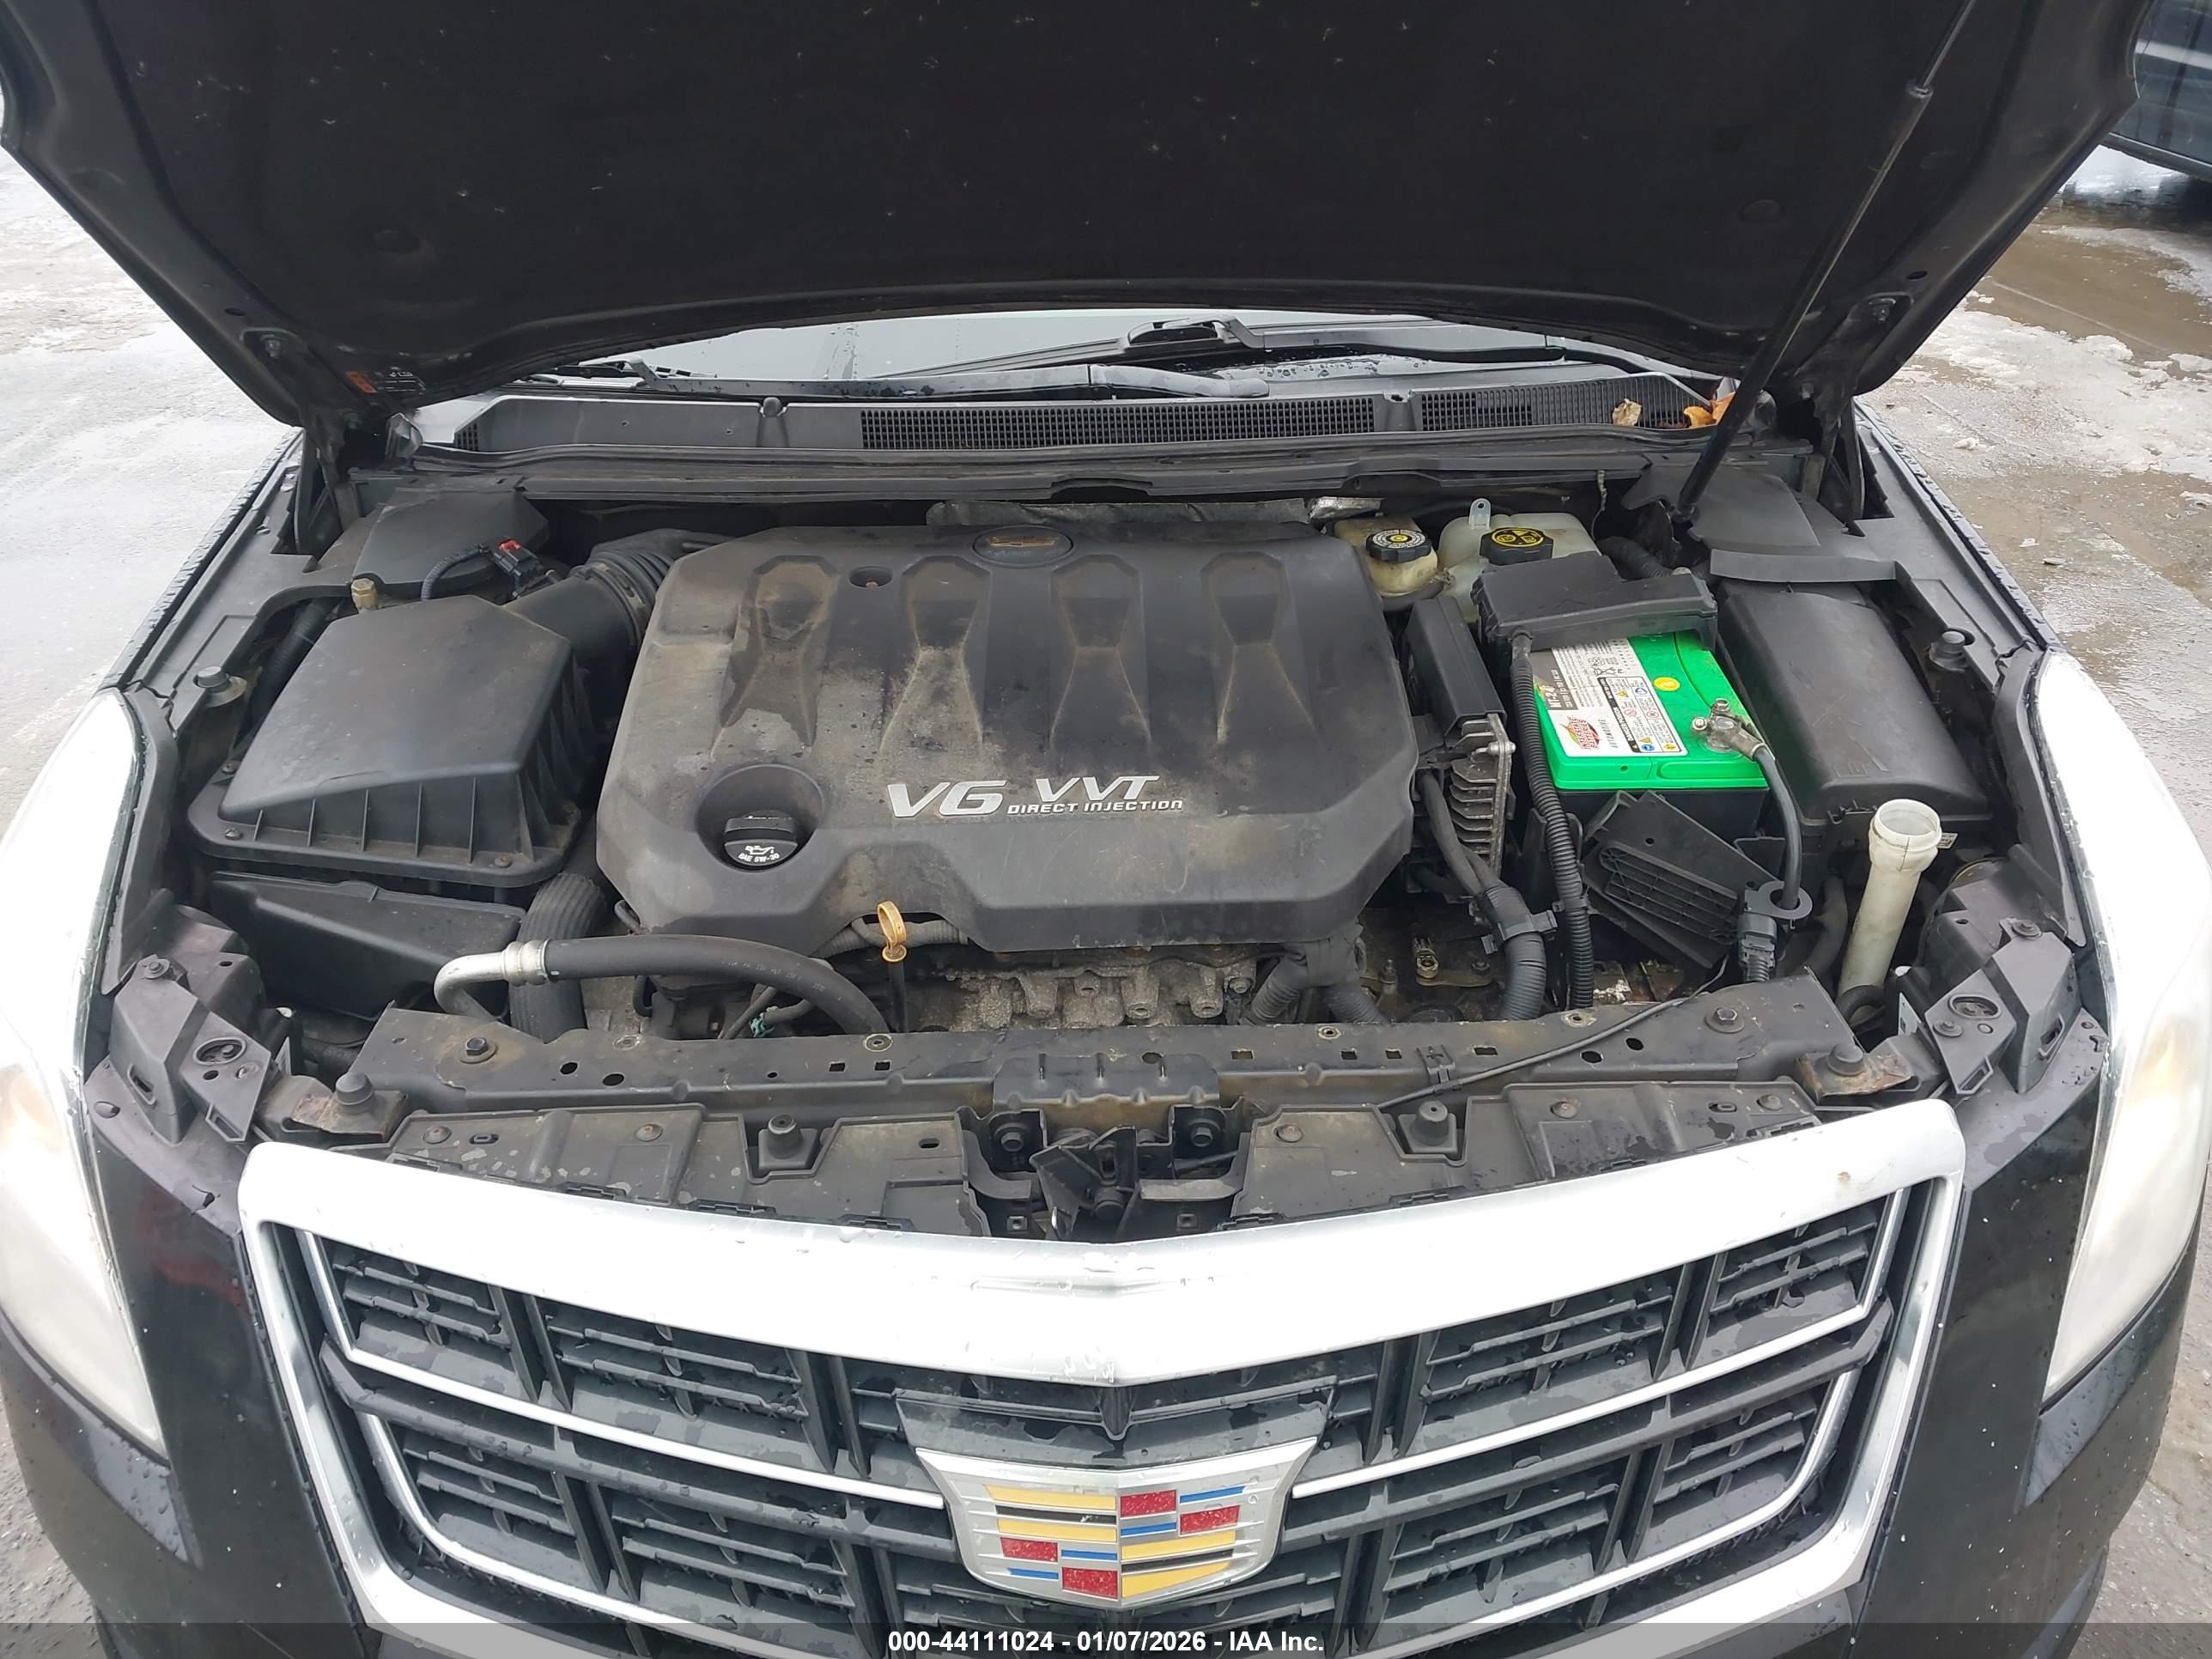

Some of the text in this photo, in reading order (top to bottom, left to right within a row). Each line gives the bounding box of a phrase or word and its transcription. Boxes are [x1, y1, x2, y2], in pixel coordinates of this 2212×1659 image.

[1567, 716, 1591, 750] INTERSTATE
[1578, 719, 1600, 750] BATTERIES
[1597, 719, 1619, 748] AUTOMOTIVE
[888, 775, 1160, 818] V6 VVT
[1007, 799, 1183, 815] DIRECT INJECTION
[738, 852, 781, 863] SAE 5W-30
